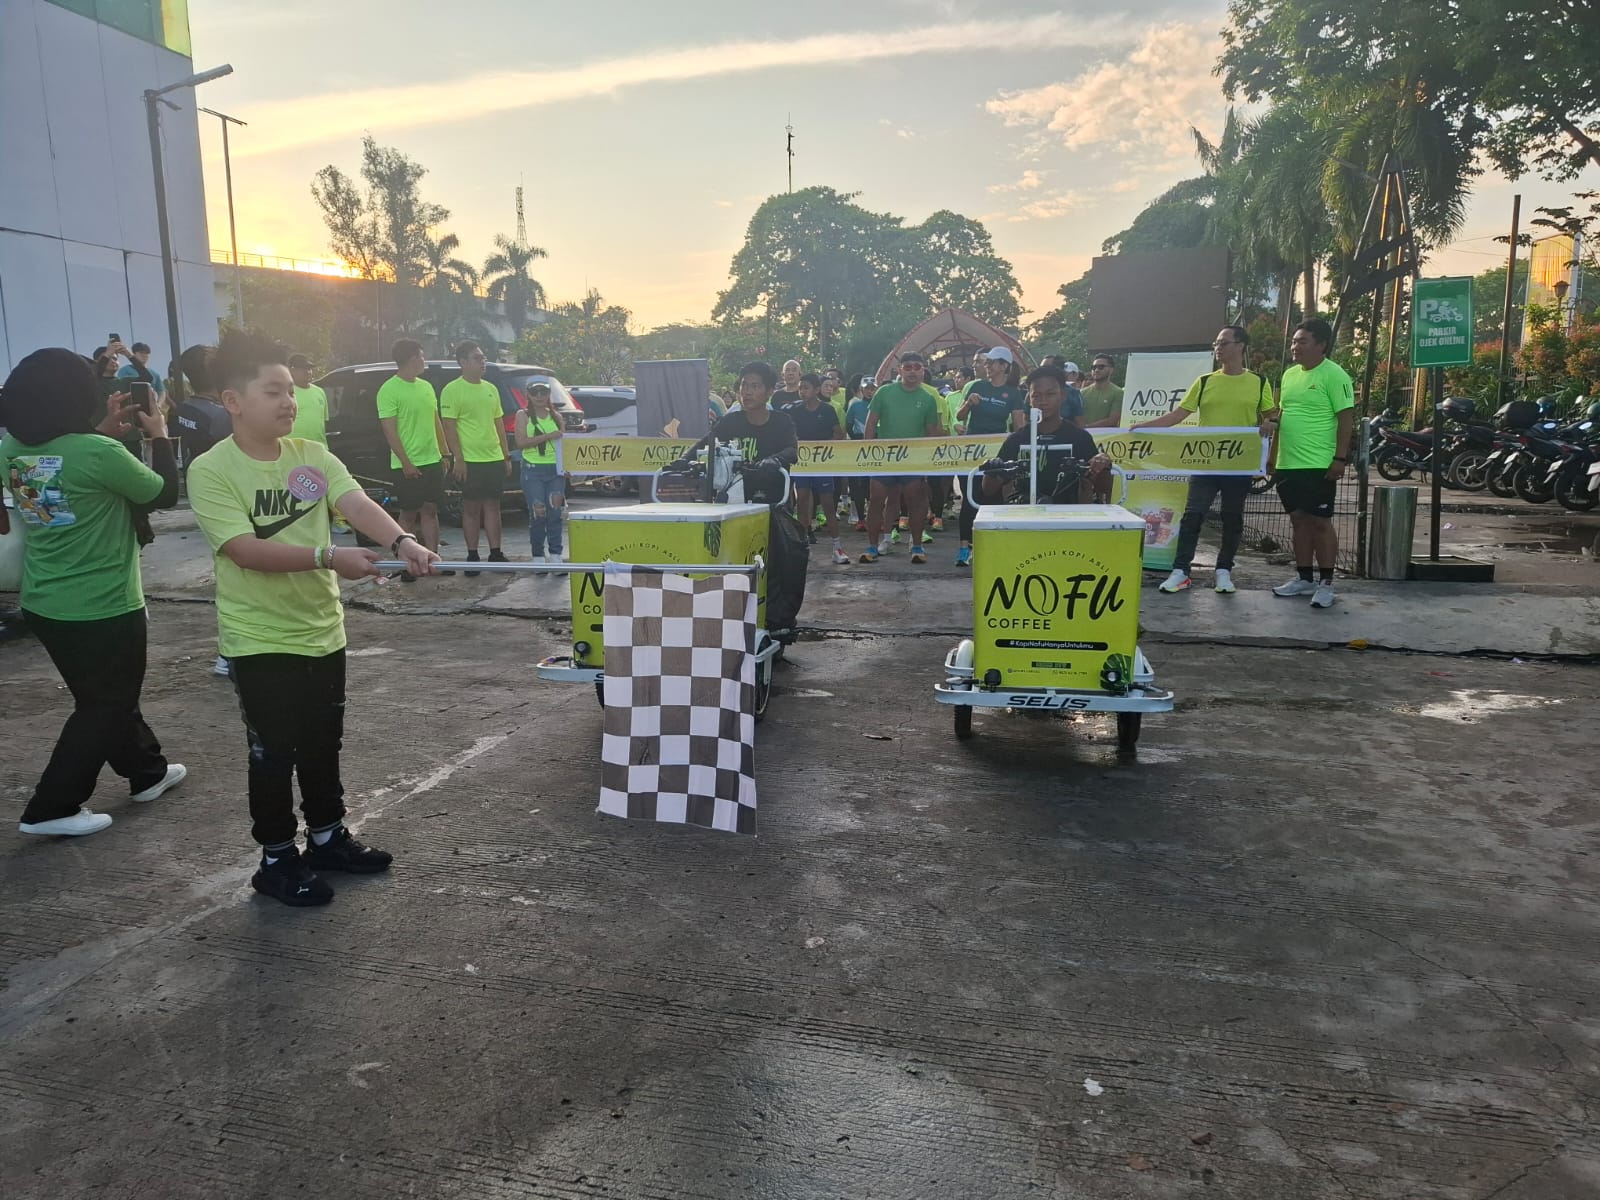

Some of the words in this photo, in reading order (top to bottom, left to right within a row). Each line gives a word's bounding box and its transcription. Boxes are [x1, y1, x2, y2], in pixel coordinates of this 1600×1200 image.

[1420, 300, 1438, 319] P
[1429, 327, 1456, 336] PARKIR
[1439, 336, 1465, 345] ONLINE
[1130, 388, 1187, 412] NOF
[575, 445, 622, 461] NOFU
[798, 445, 834, 463] OFU
[856, 445, 909, 463] NOFU
[931, 444, 987, 462] NOFU
[1179, 440, 1244, 460] NOFU
[296, 474, 318, 492] 880
[253, 488, 302, 517] NIKE
[1062, 550, 1085, 559] KOPI
[1089, 558, 1110, 573] ASLI
[984, 574, 1125, 620] NOFU
[988, 617, 1051, 630] COFFEE
[1007, 695, 1091, 709] SELIS
